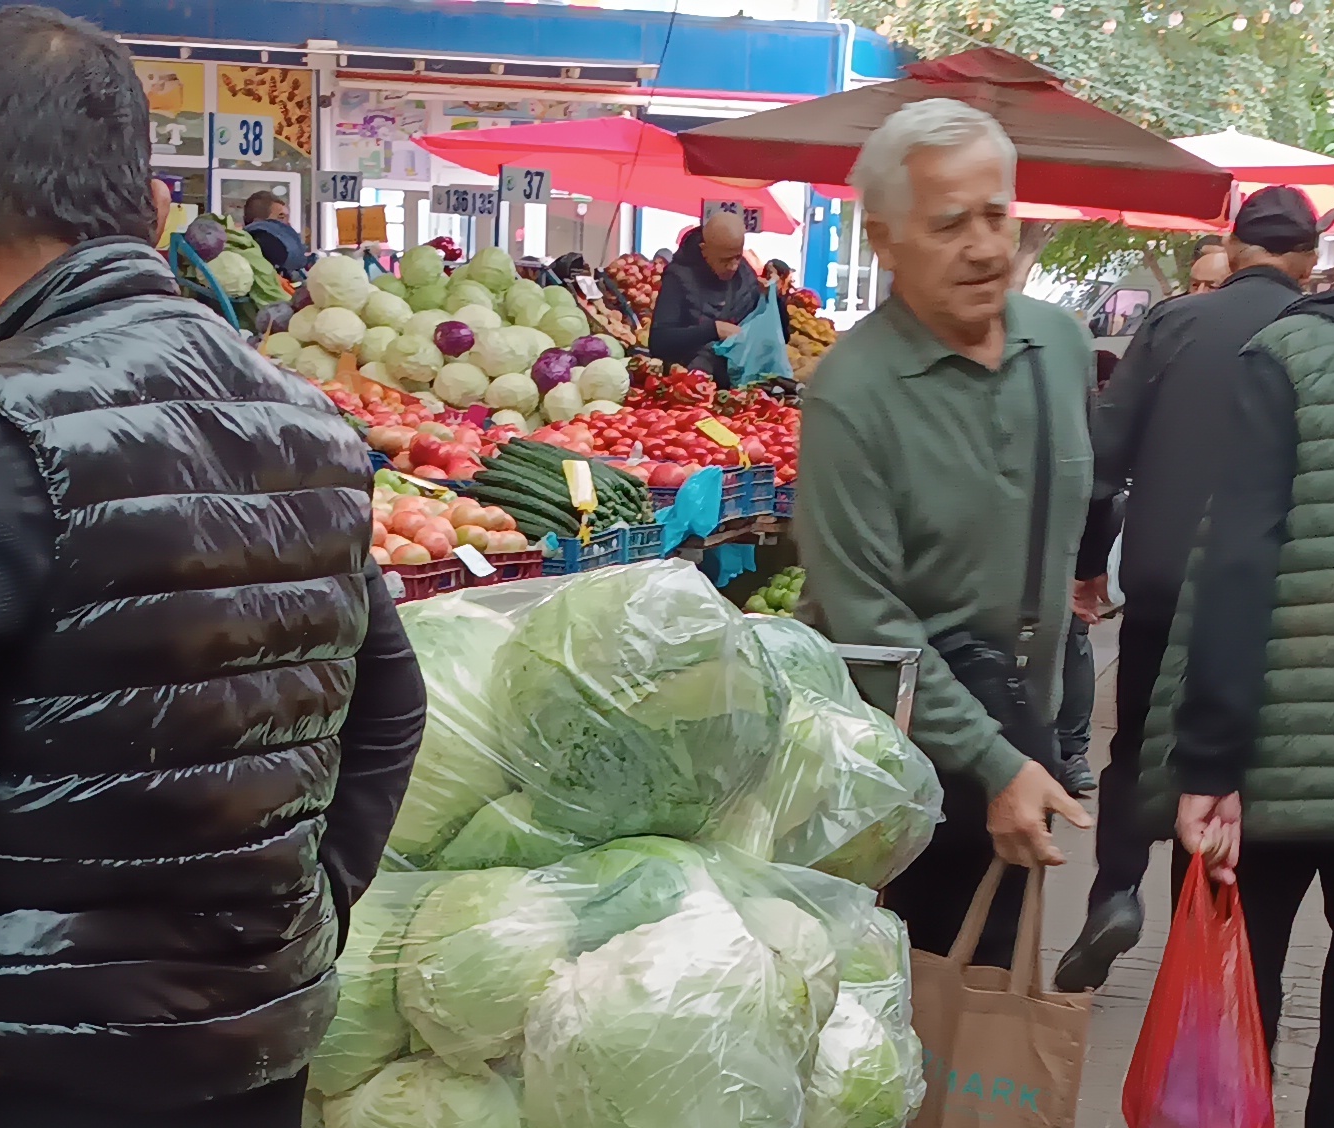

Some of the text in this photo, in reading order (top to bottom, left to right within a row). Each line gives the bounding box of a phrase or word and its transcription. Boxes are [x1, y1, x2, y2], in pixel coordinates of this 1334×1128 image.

[238, 119, 264, 156] 38
[331, 174, 359, 200] 137
[523, 170, 545, 200] 37
